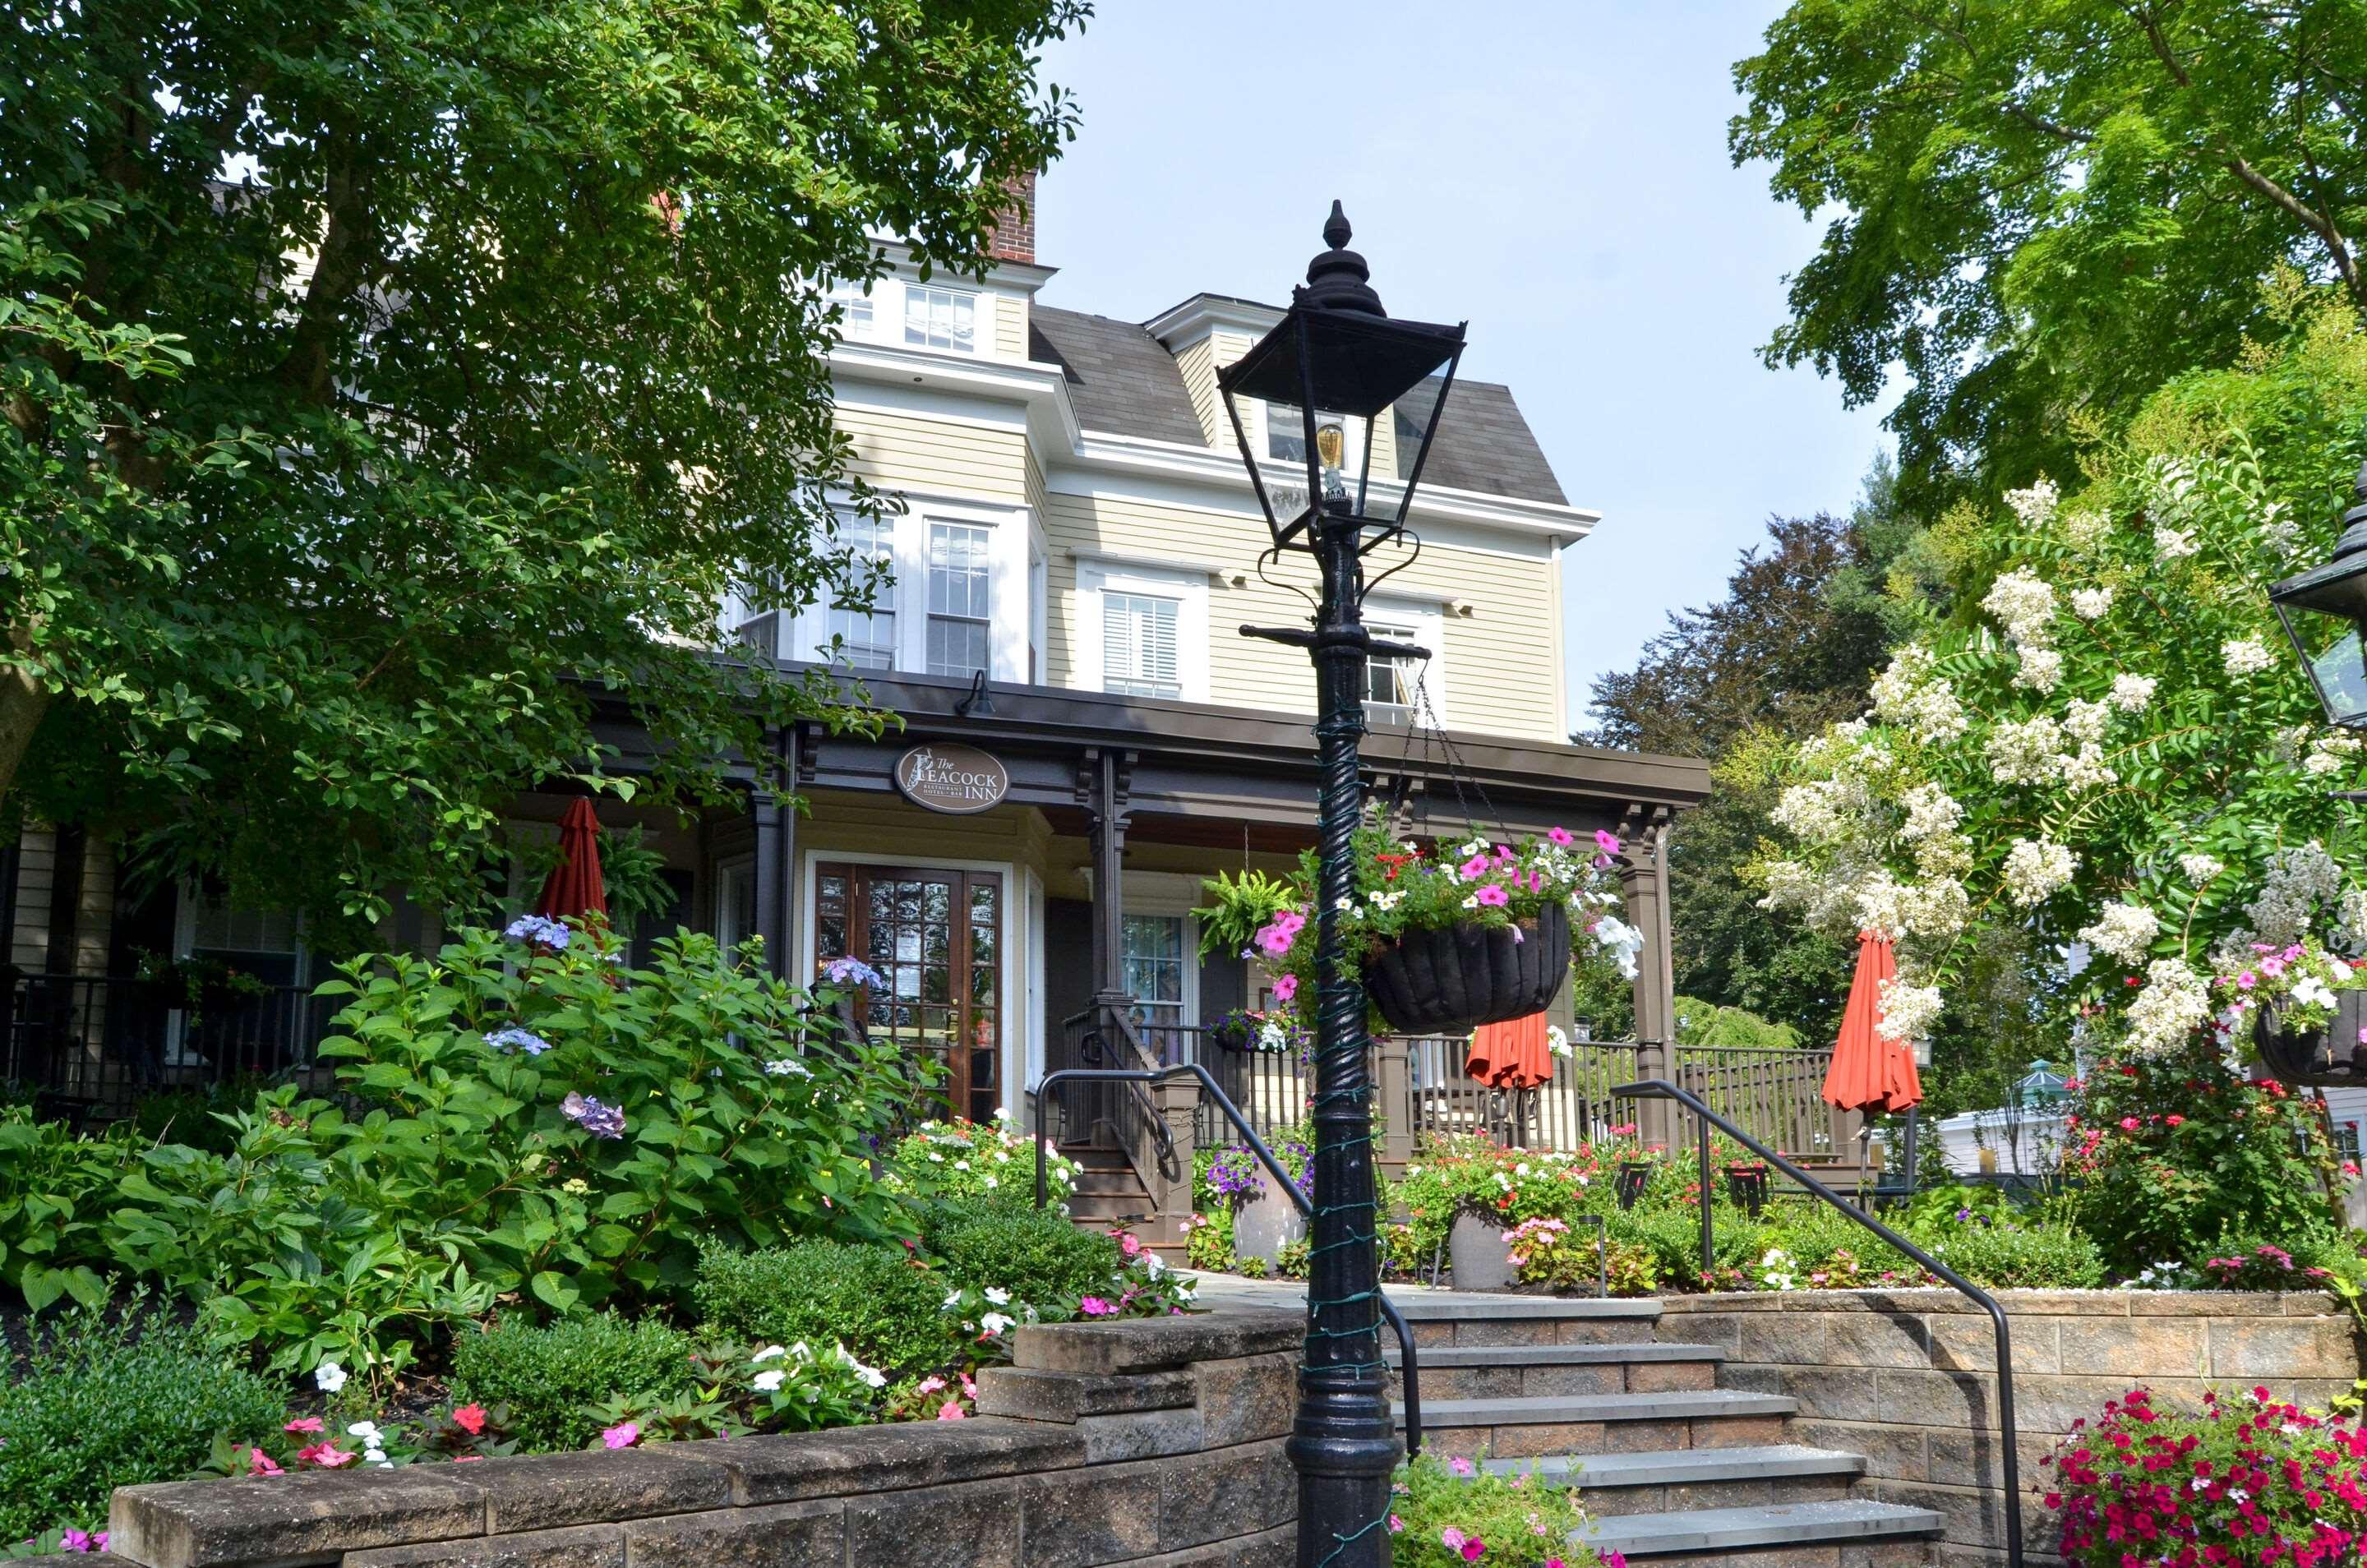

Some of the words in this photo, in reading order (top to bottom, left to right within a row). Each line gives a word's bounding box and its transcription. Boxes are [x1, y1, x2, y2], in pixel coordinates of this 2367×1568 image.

[914, 754, 997, 787] PEACOCK
[937, 758, 954, 770] The
[965, 786, 997, 800] INN
